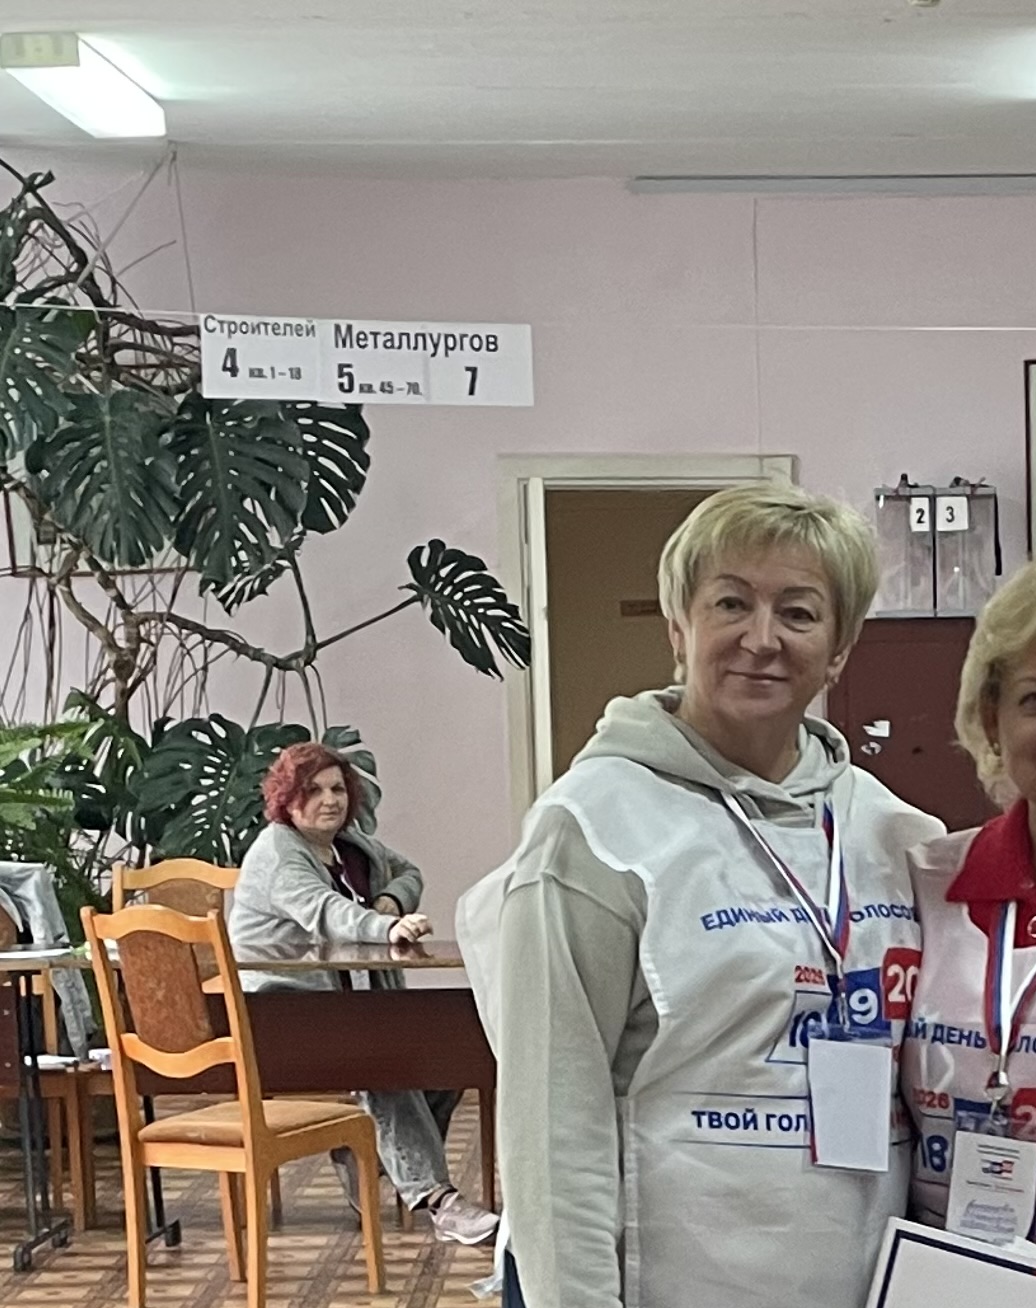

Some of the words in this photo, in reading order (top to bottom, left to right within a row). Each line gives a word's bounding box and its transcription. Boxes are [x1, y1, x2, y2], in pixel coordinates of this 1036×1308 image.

[204, 314, 316, 339] Строителей
[334, 324, 498, 357] Металлургов
[222, 347, 239, 377] 4
[337, 363, 355, 393] 5
[464, 366, 478, 396] 7
[915, 508, 926, 524] 2
[945, 506, 955, 523] 3
[700, 907, 790, 931] ЕДИНЫЙ
[931, 1023, 987, 1050] ДЕНЬ
[691, 1107, 759, 1131] ТВОЙ
[765, 1113, 808, 1132] ГОЛ
